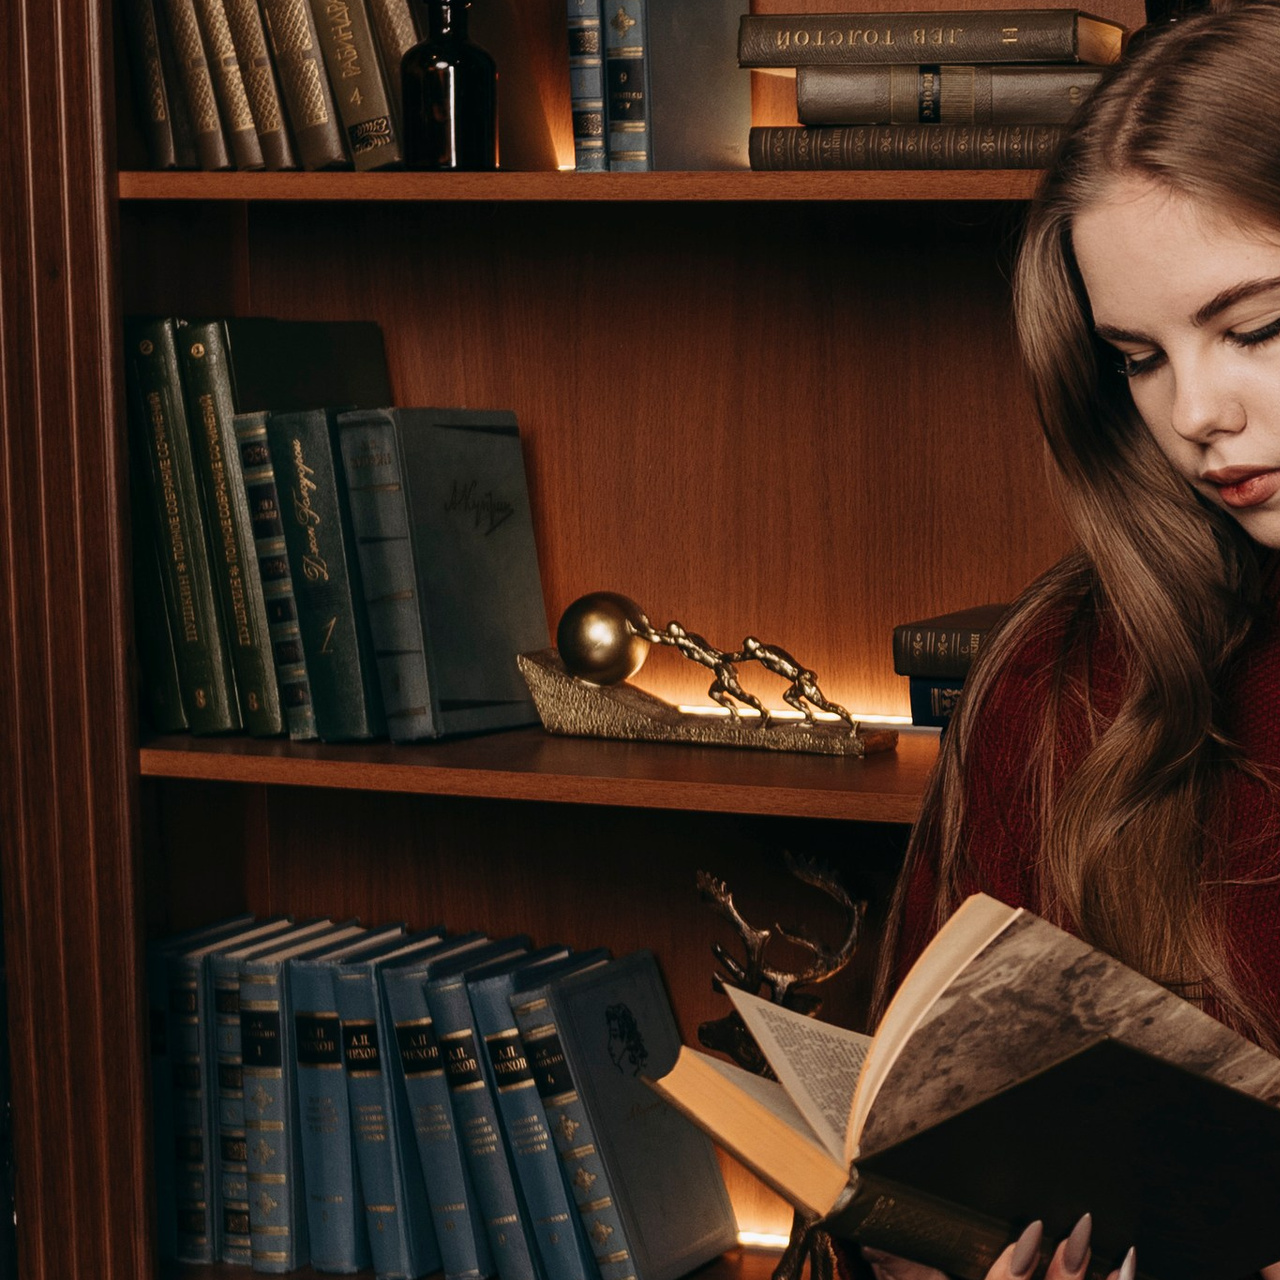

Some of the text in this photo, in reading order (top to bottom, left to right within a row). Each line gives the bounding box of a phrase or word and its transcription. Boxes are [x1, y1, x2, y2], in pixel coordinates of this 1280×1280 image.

[775, 26, 964, 49] ЛЕВ ТОЛСТОЙ
[349, 87, 365, 105] 4
[981, 140, 997, 155] 3
[176, 574, 199, 642] ПУШКИН
[229, 577, 252, 646] ПУШКИН
[346, 1047, 378, 1060] ЧЕХОВ
[402, 1046, 439, 1061] ЧЕХОВ
[493, 1056, 529, 1074] ЧЕХОВ
